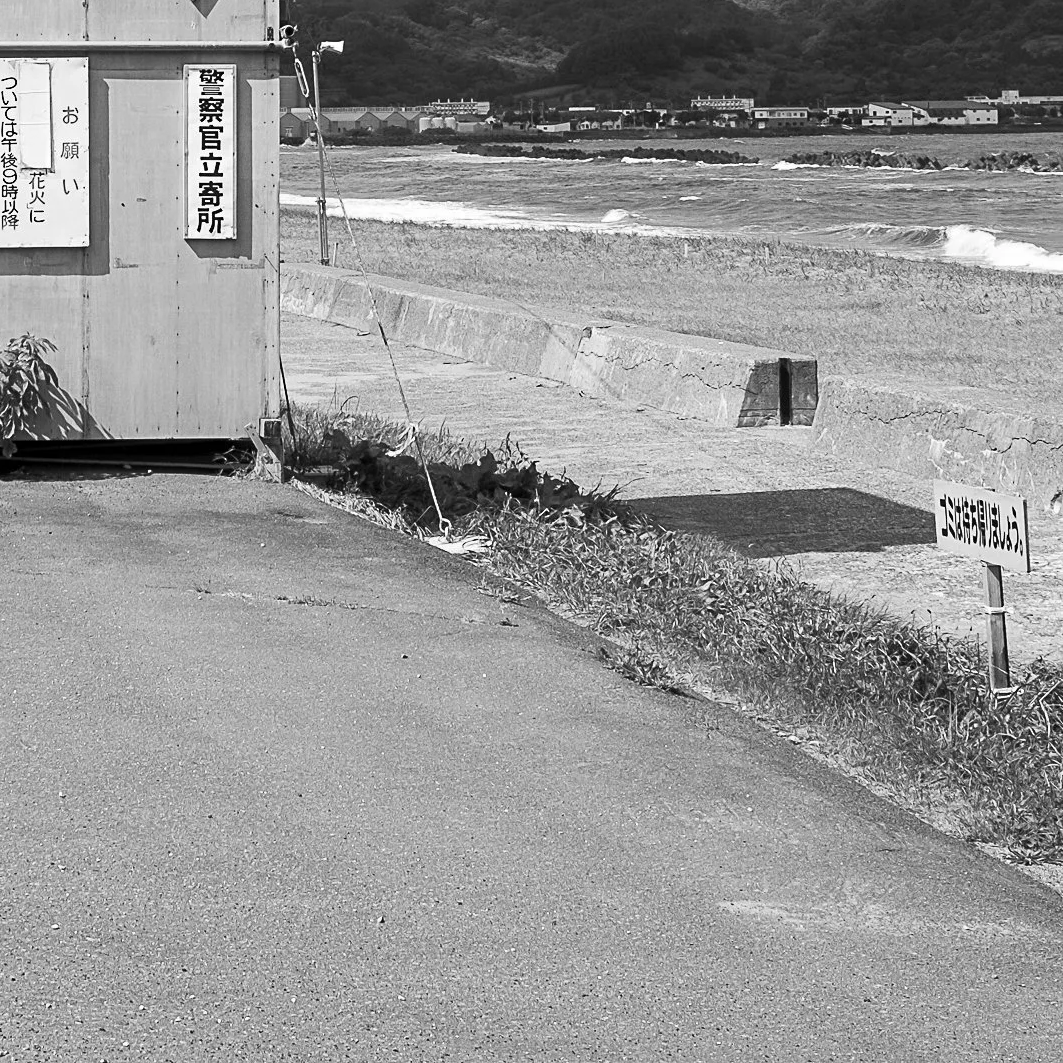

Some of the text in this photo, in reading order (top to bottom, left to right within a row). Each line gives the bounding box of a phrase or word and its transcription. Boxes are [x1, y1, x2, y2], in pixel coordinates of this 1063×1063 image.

[0, 76, 19, 230] ついては午後9時以降
[61, 105, 80, 195] お願い
[196, 69, 225, 233] 警察官立寄所
